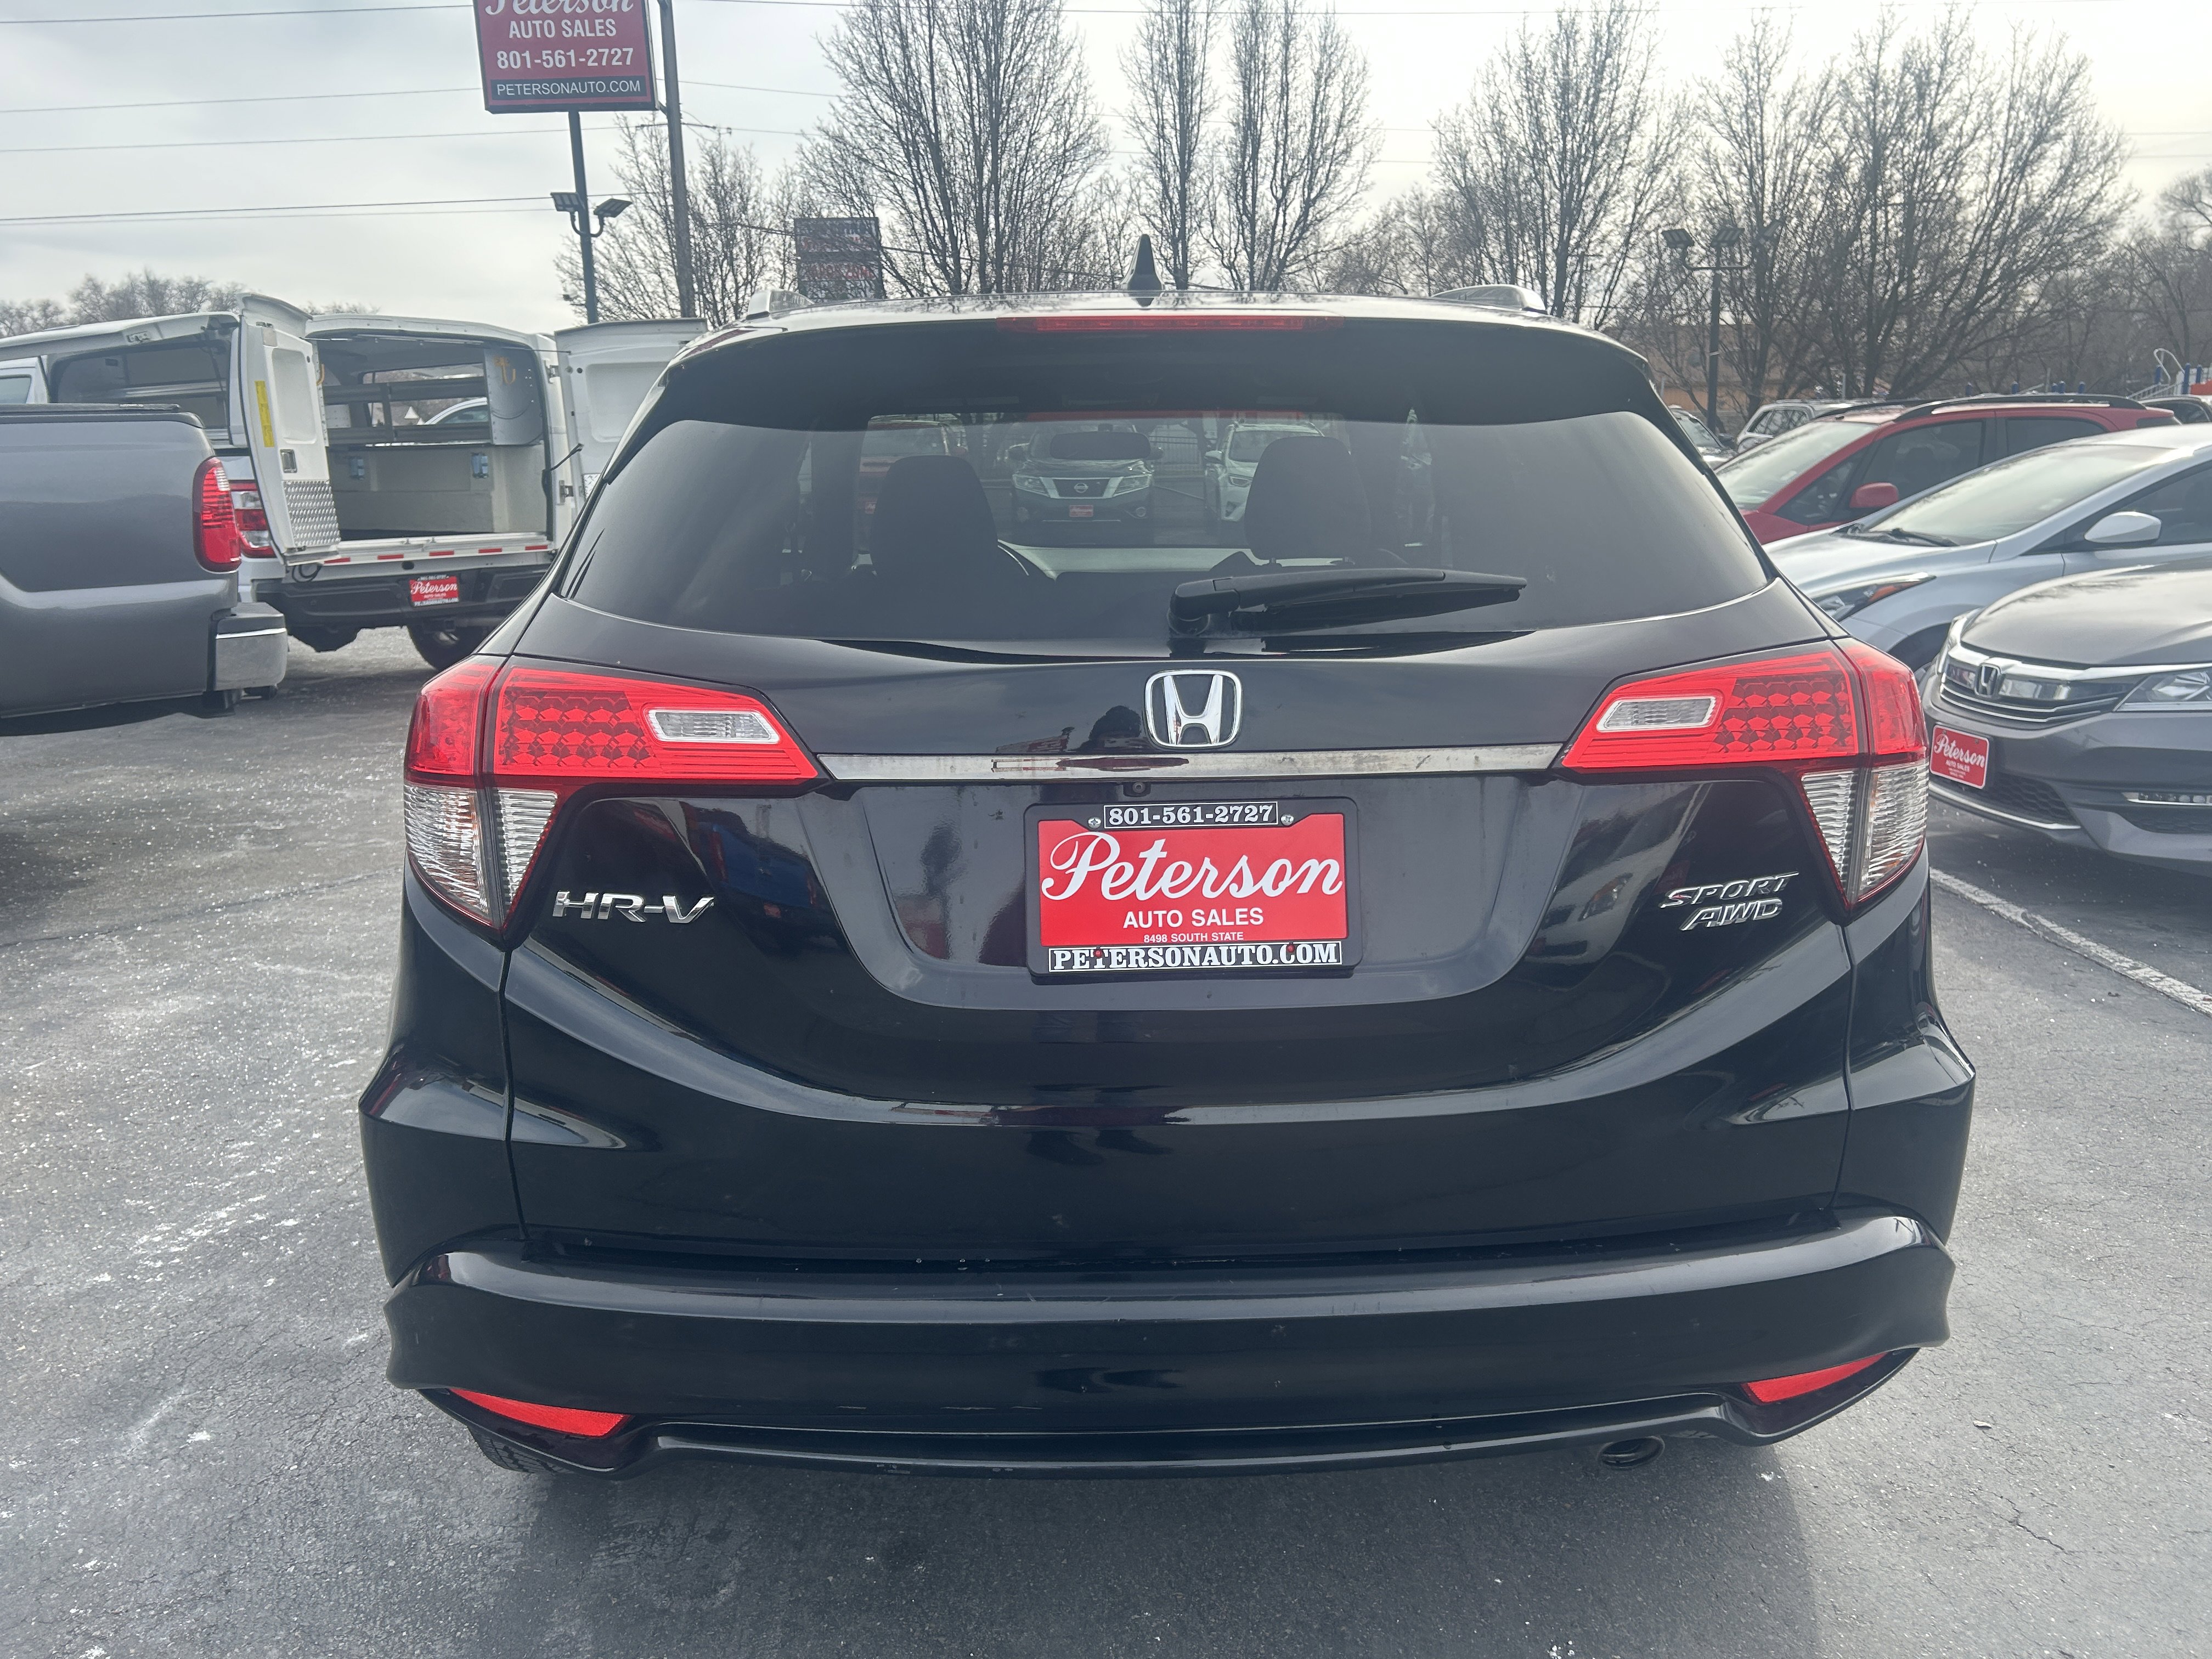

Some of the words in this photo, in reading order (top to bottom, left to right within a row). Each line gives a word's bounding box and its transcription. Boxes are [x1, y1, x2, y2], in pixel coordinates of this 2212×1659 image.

[509, 20, 556, 38] AUTO
[561, 18, 617, 38] SALES
[496, 48, 633, 69] 801-561-2727
[496, 80, 641, 95] PETERSONAUTO.COM
[410, 581, 458, 595] Peterson
[1934, 733, 1985, 768] Peterson
[1109, 805, 1273, 825] 801-561-2727
[1041, 832, 1343, 901] Peterson
[1659, 871, 1799, 909] SPORT
[552, 891, 714, 924] HR-V
[1123, 909, 1183, 929] AUTO
[1191, 907, 1263, 927] SALES
[1679, 898, 1783, 931] AWD
[1143, 934, 1168, 943] 8498
[1171, 933, 1207, 942] SOUTH
[1211, 932, 1244, 941] STATE
[1053, 943, 1338, 970] PETERSONAUTO.COM
